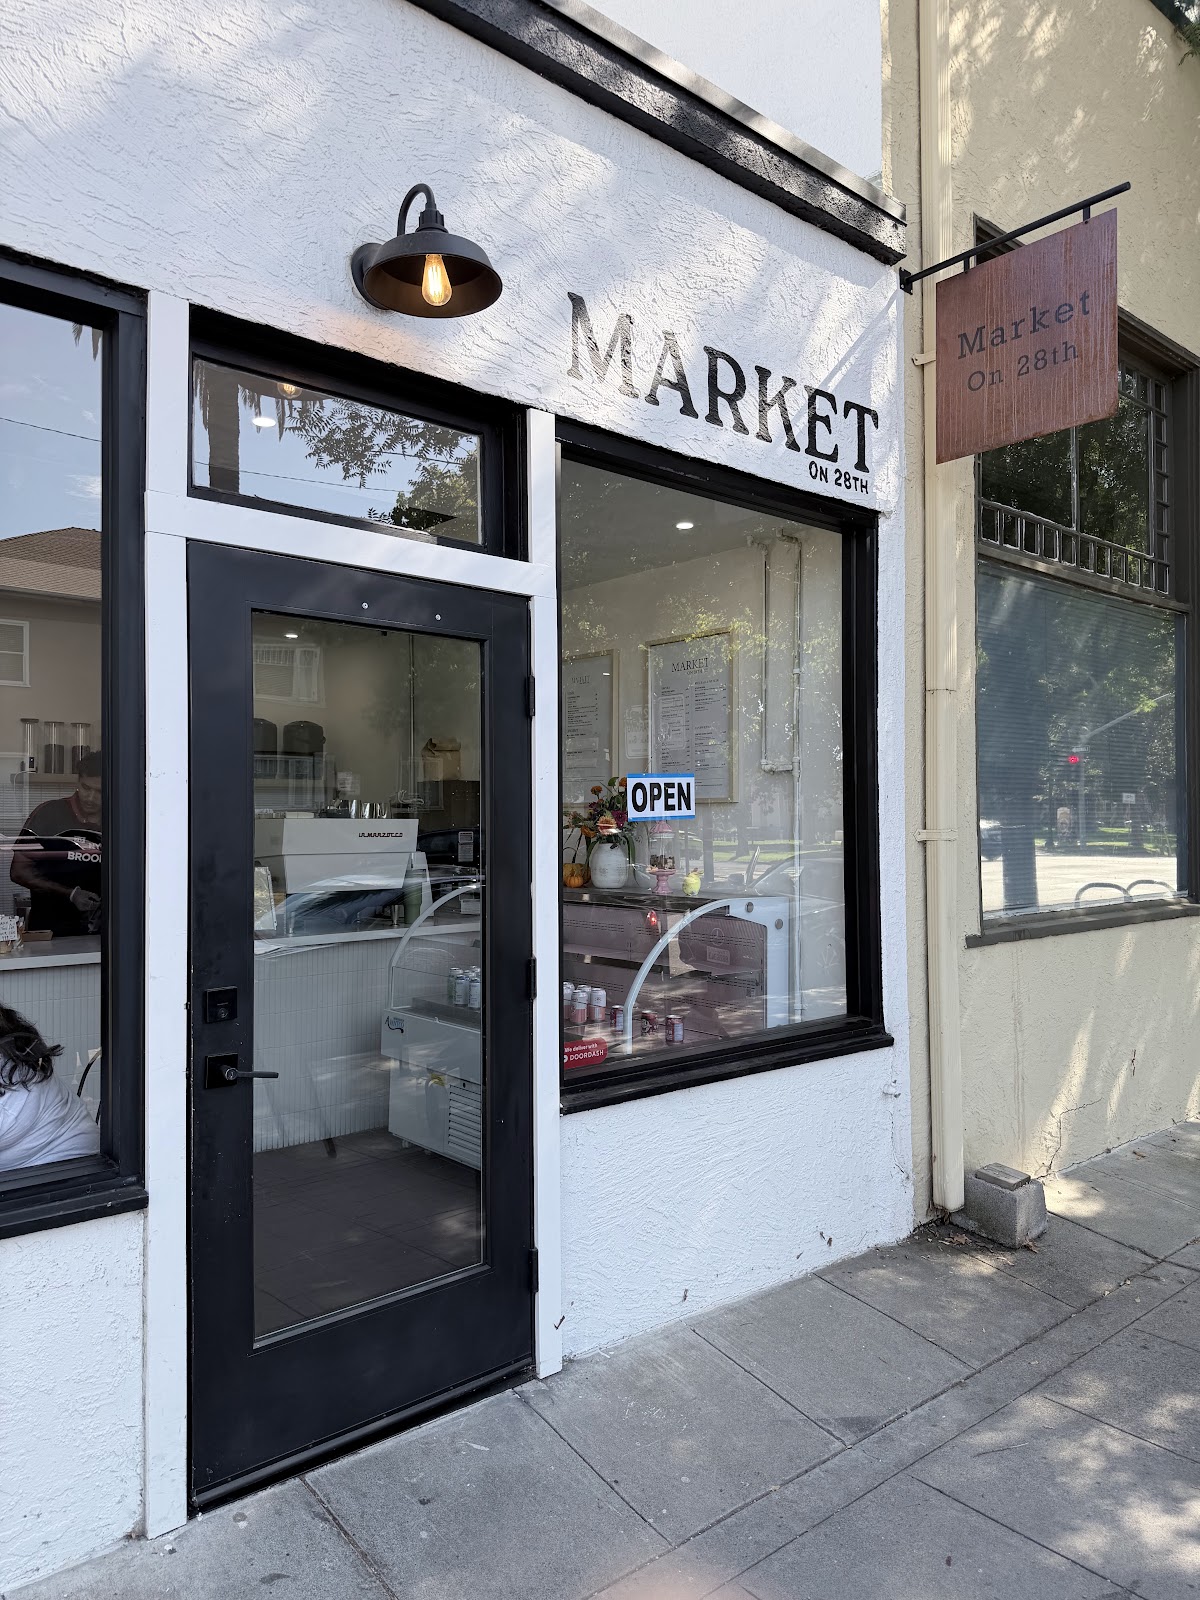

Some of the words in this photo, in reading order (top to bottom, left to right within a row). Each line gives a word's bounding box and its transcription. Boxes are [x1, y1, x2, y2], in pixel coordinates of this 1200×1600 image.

[957, 290, 1090, 360] Market
[567, 291, 879, 473] MARKET
[967, 370, 1004, 392] On
[1017, 341, 1079, 377] 28th
[809, 460, 829, 484] ON
[834, 468, 869, 495] 28TH
[671, 657, 708, 673] MARKET
[631, 782, 692, 813] OPEN
[67, 851, 102, 863] BROO
[570, 1050, 603, 1060] DOORDASH
